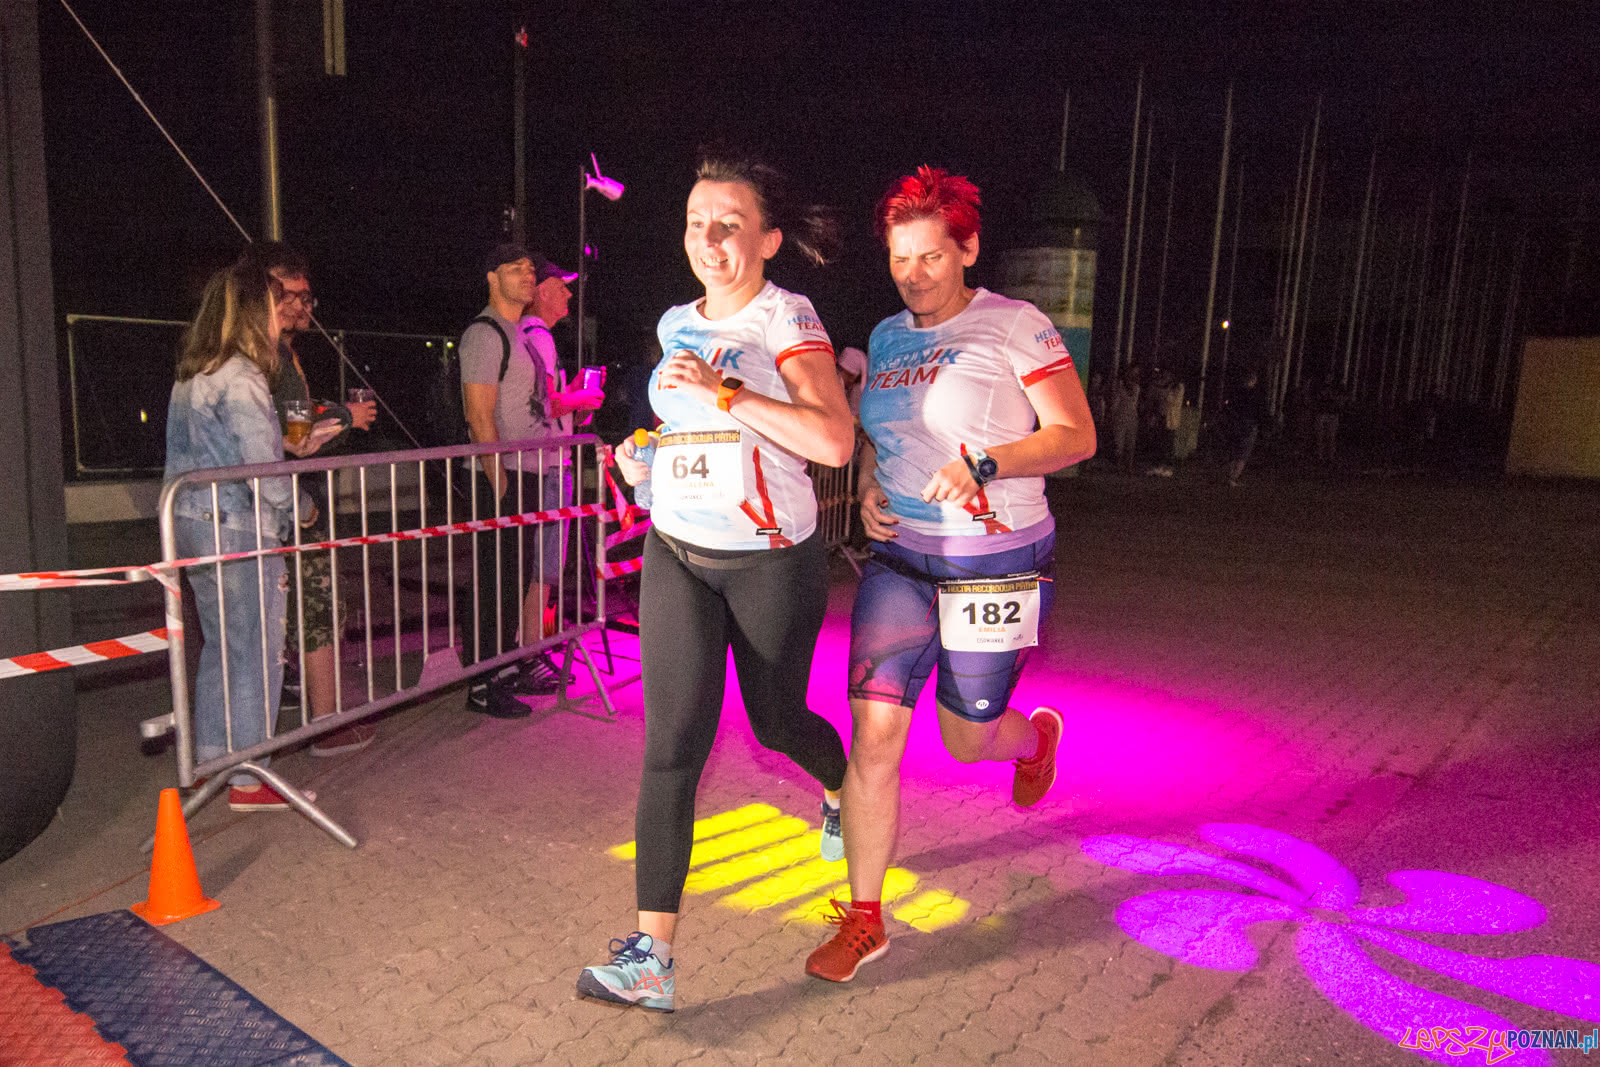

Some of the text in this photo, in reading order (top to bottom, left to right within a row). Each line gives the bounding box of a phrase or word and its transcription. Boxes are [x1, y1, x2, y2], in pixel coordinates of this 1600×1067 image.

[869, 366, 941, 390] TEAM
[672, 453, 710, 479] 64
[962, 601, 1021, 625] 182
